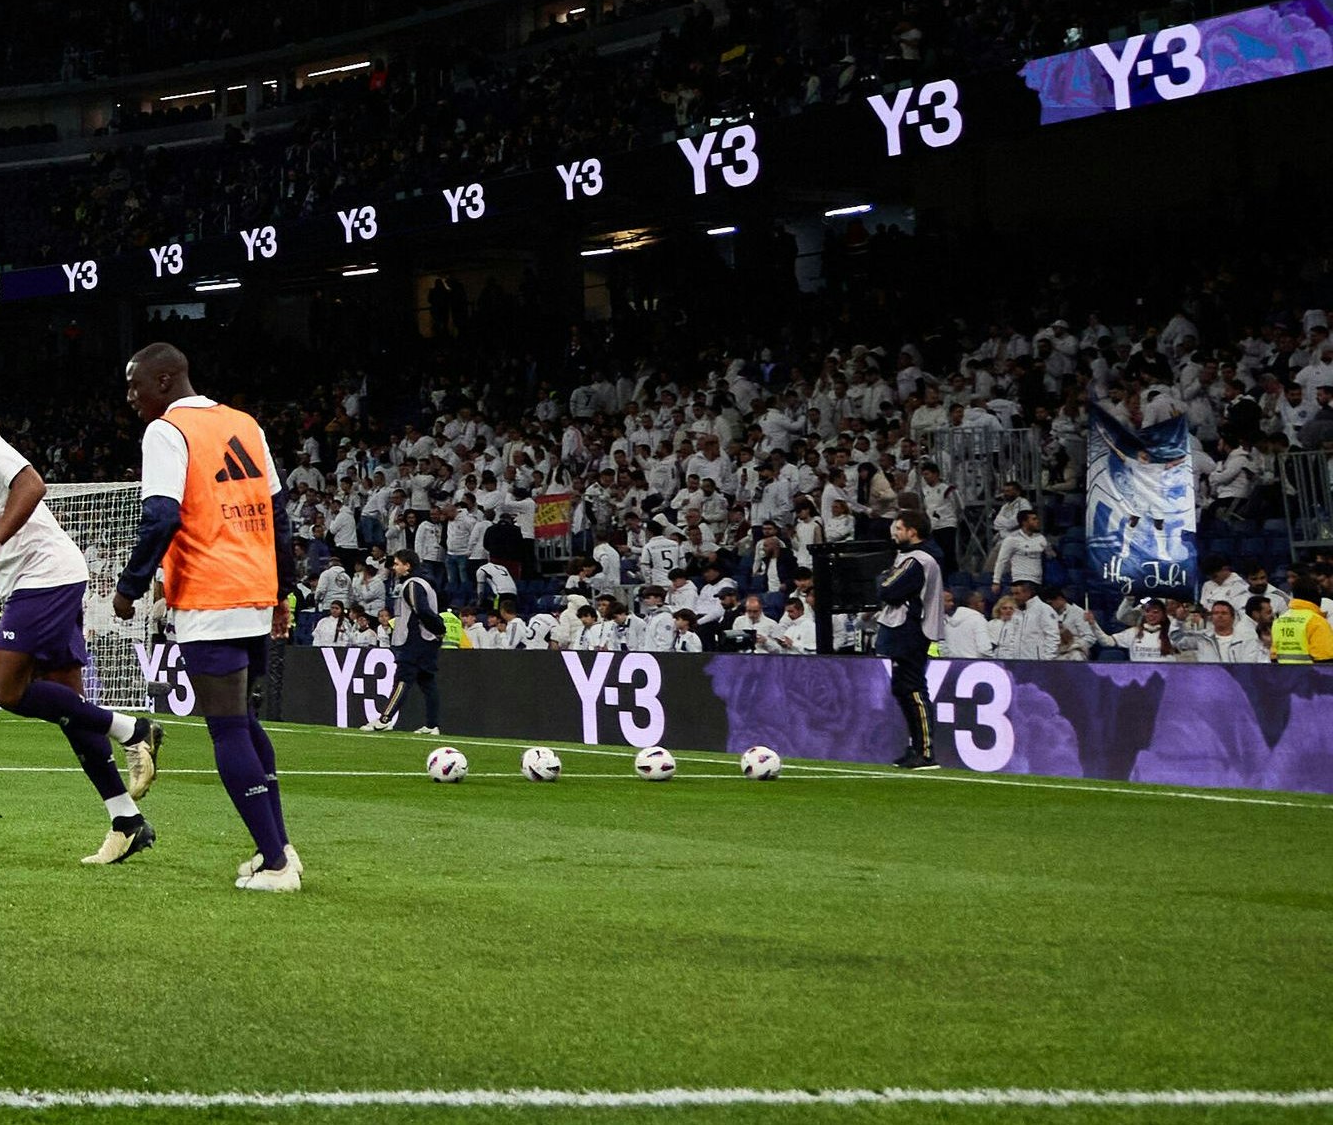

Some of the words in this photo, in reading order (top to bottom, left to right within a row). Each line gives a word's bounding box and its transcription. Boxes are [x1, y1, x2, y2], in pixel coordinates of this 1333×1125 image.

[1091, 24, 1204, 110] Y-3
[867, 79, 962, 156] Y-3
[677, 125, 759, 194] Y-3
[557, 159, 602, 200] Y-3
[443, 184, 484, 222] Y-3
[240, 226, 277, 260] Y-3
[338, 206, 377, 242] Y-3
[62, 261, 97, 292] Y-3
[150, 244, 183, 276] Y-3
[661, 549, 674, 570] 5
[322, 648, 400, 729] Y-3
[561, 651, 665, 748] Y-3
